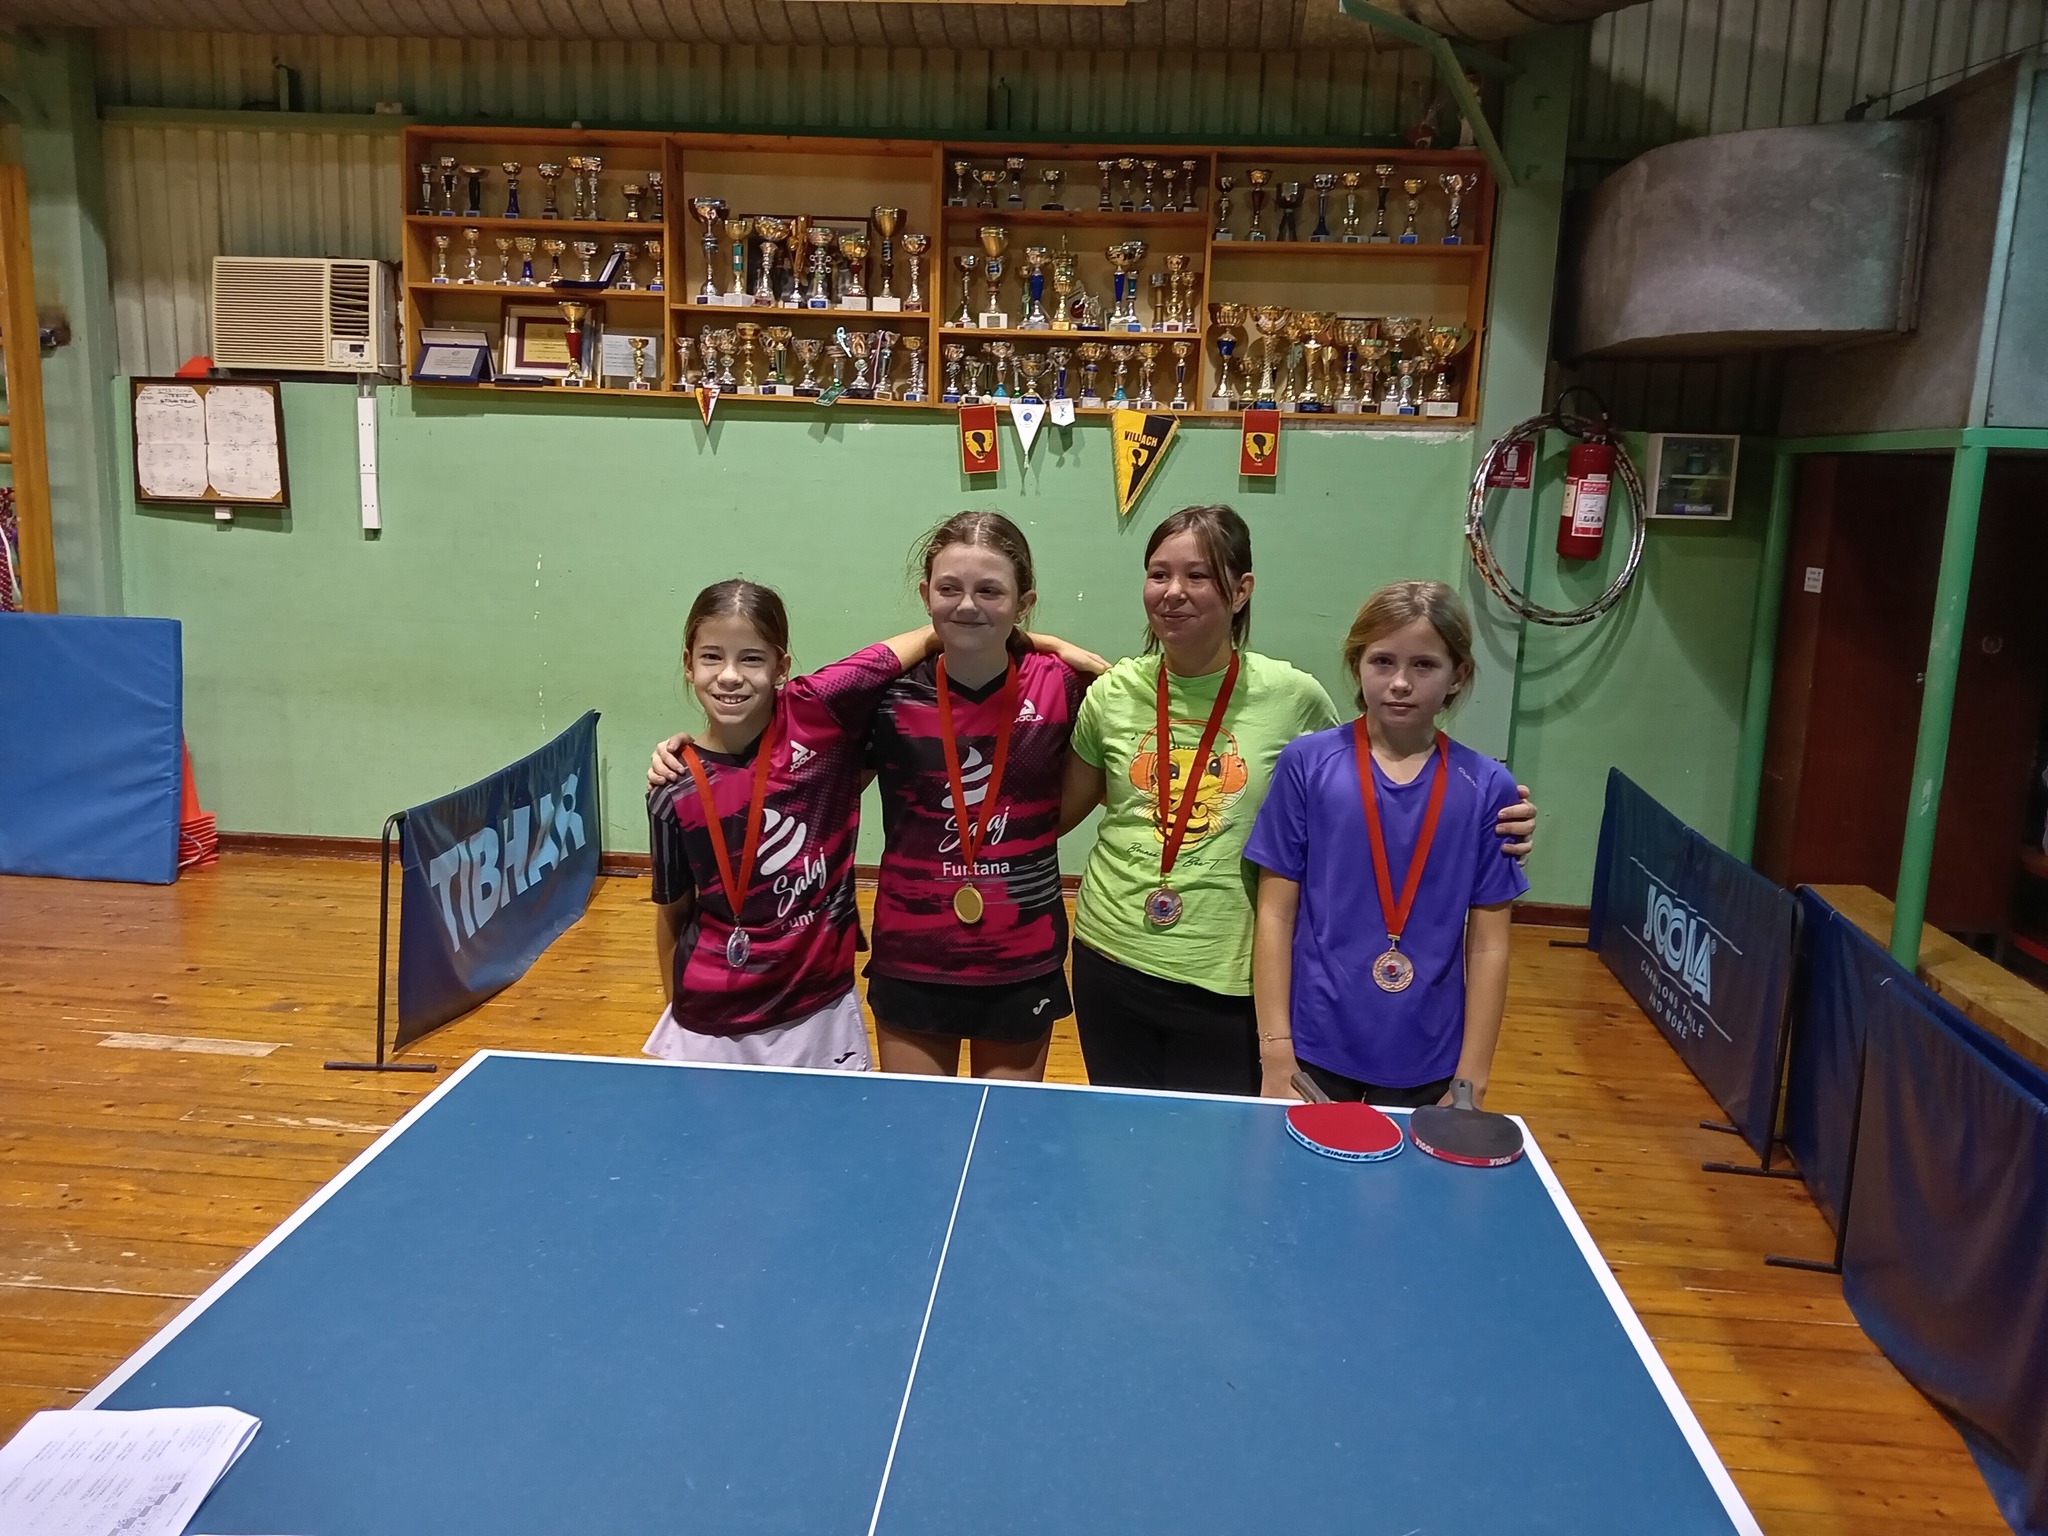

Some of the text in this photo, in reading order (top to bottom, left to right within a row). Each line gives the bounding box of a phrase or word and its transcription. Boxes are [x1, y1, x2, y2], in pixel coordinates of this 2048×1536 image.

[1124, 431, 1159, 448] VILLACH
[1013, 714, 1044, 724] JOOLA
[789, 750, 818, 773] JOOLA
[938, 806, 1010, 854] Saaj
[430, 773, 586, 953] TIBHAR
[773, 847, 827, 918] Salaj
[1643, 884, 1712, 1006] JOOLA
[1640, 960, 1705, 1039] CHAMIONS TALE
[1665, 1011, 1689, 1040] MORE
[1323, 1149, 1361, 1160] DONIC
